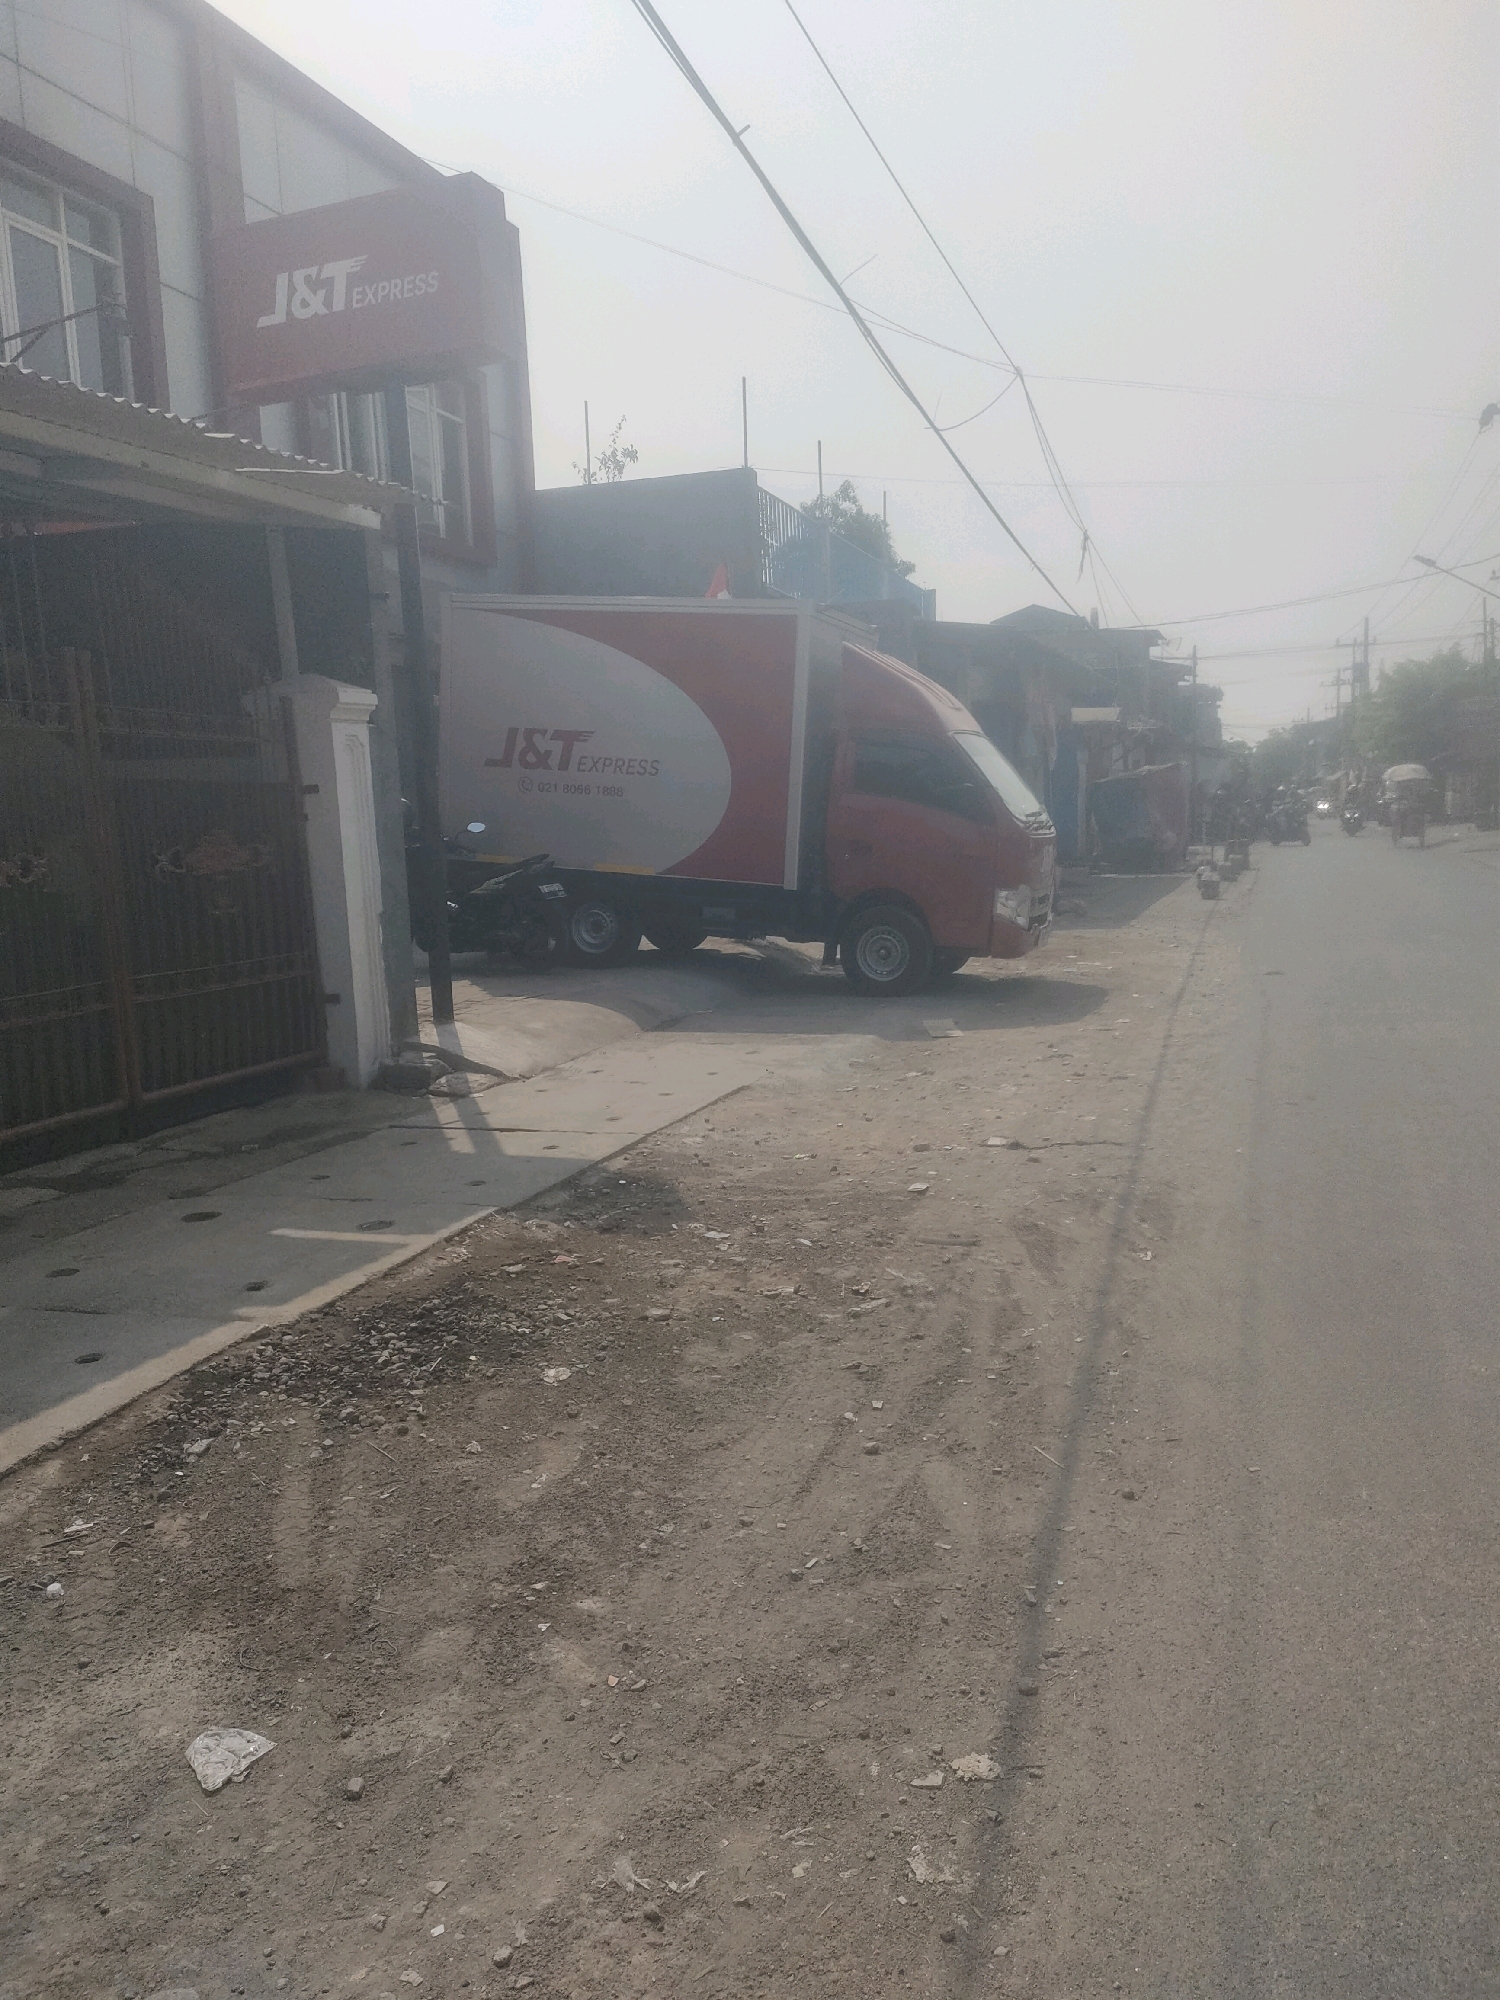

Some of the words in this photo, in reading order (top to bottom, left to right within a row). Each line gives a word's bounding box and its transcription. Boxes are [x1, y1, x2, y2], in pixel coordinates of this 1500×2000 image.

[257, 255, 368, 328] J&T
[352, 271, 439, 309] EXPRESS
[484, 727, 595, 772] J&T
[576, 755, 660, 777] EXPRESS
[537, 782, 558, 794] 021
[562, 783, 592, 796] 8066
[595, 785, 624, 798] 1888
